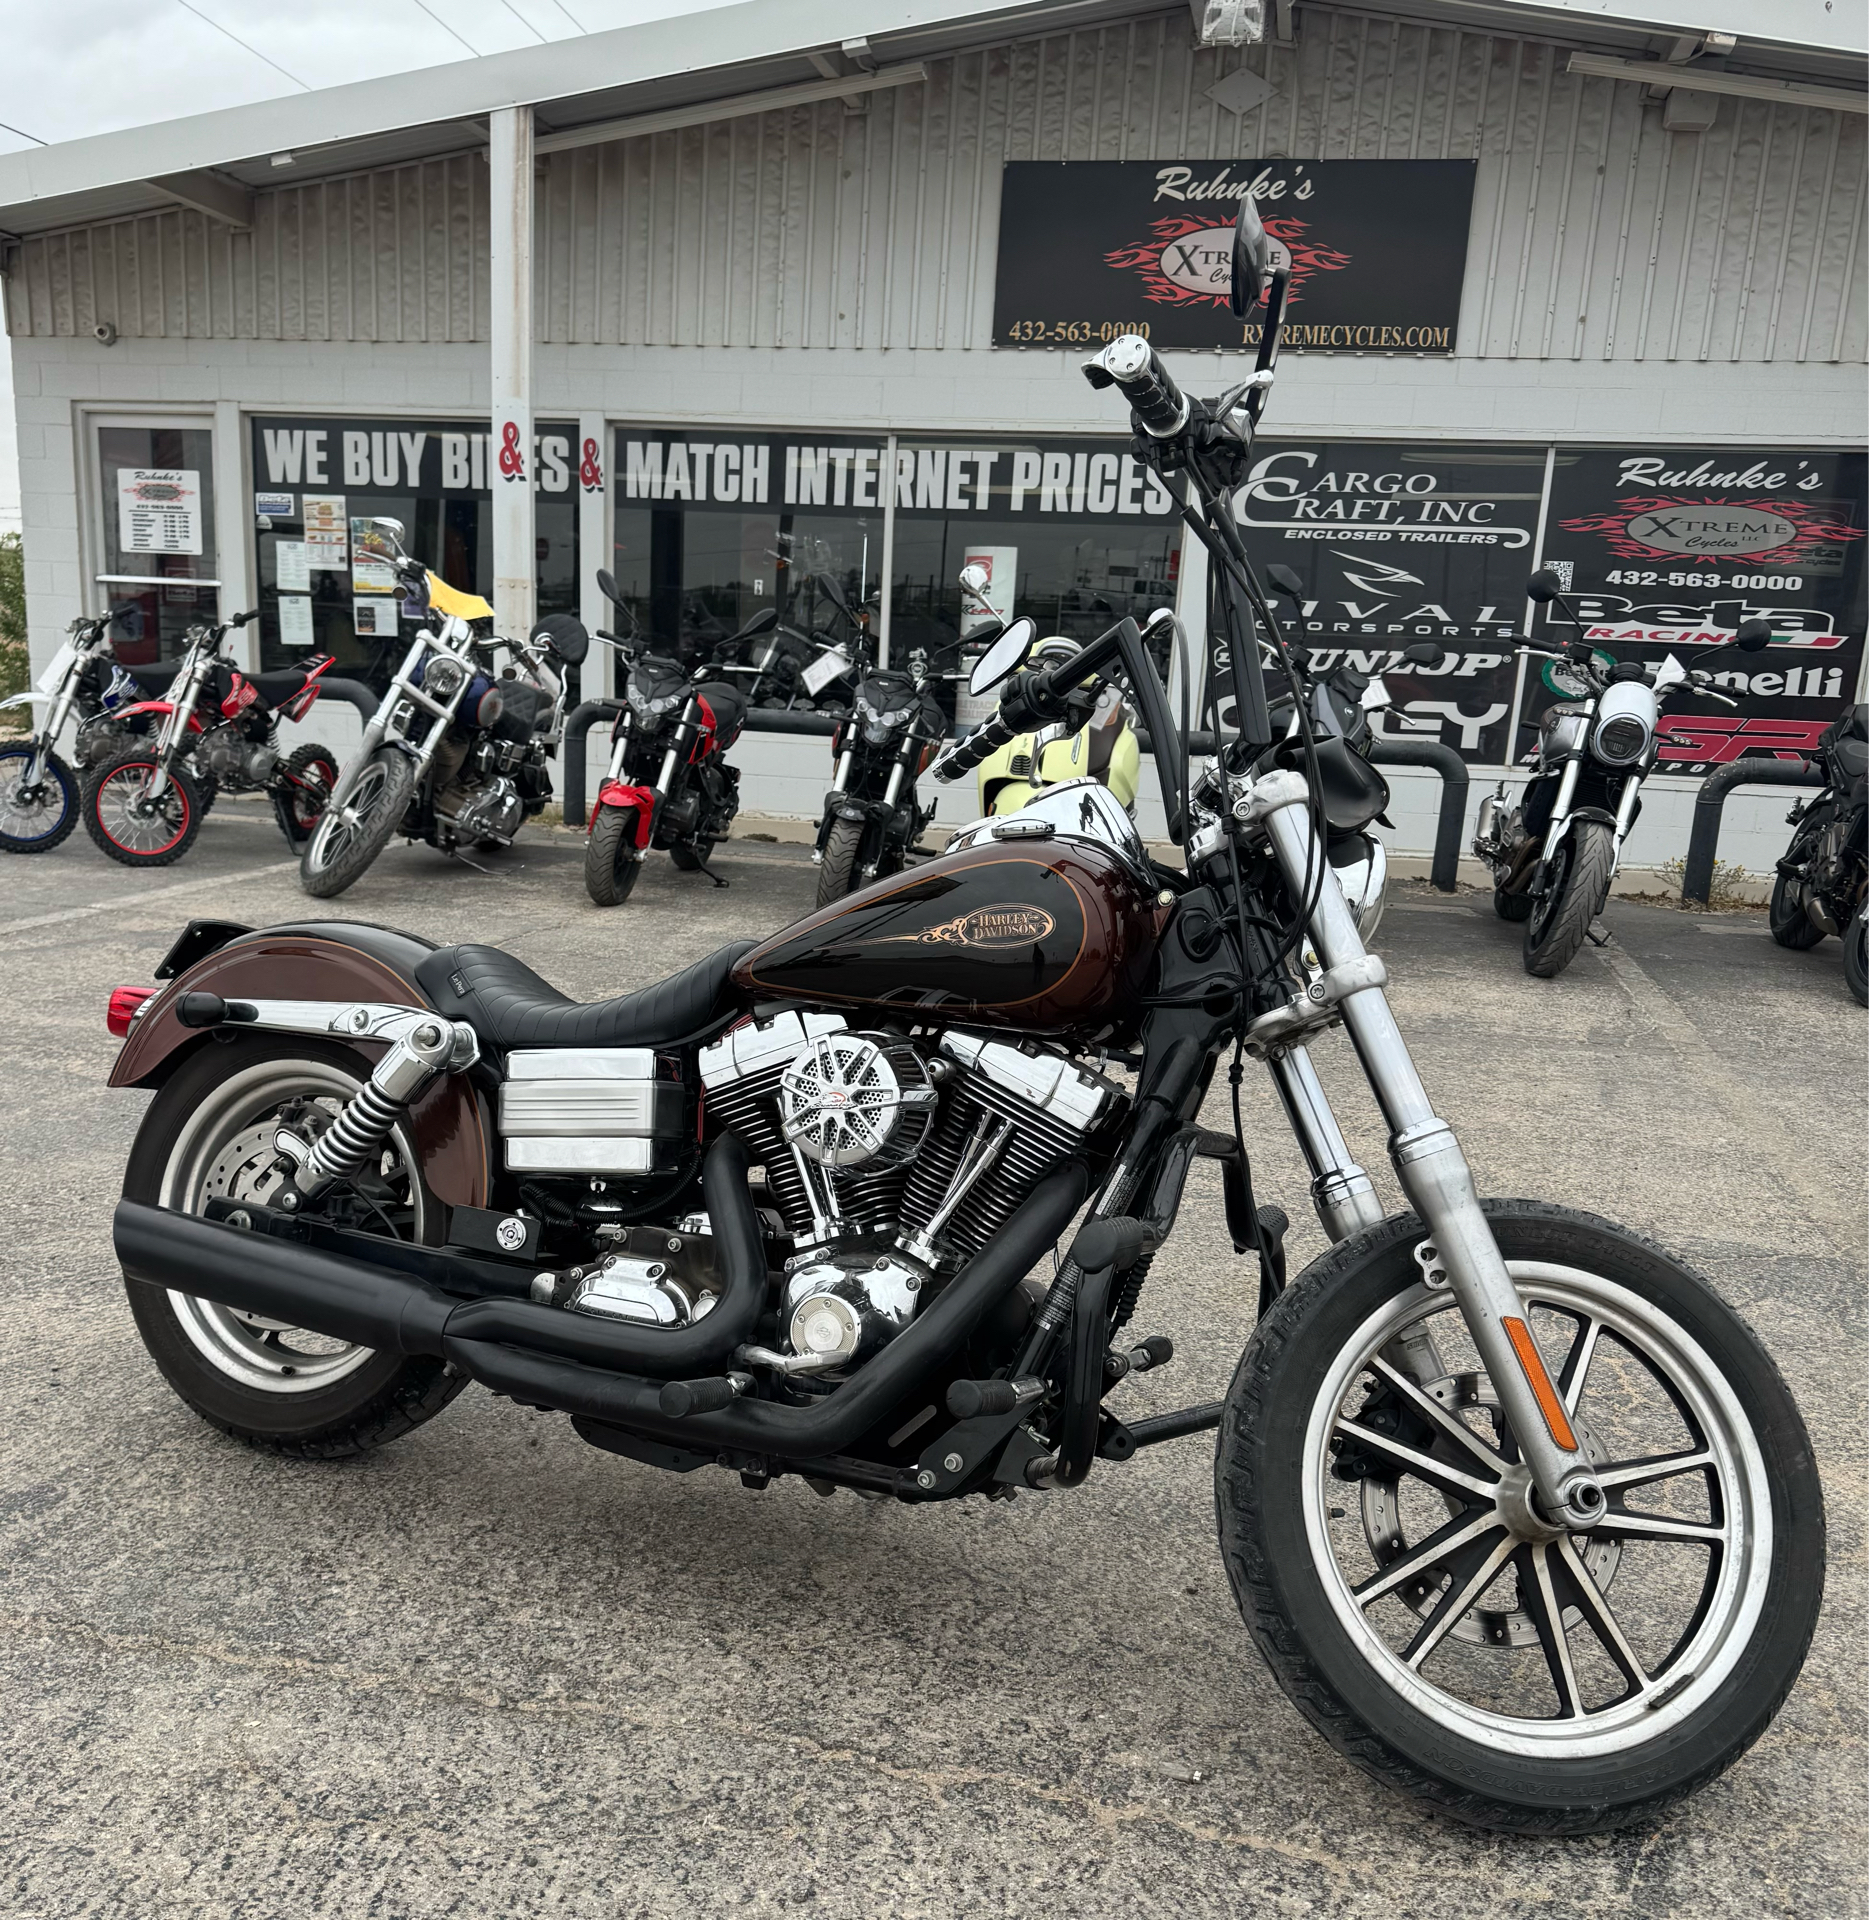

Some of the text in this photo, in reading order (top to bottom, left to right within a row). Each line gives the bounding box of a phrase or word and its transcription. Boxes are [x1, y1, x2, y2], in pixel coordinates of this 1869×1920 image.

[1153, 166, 1314, 202] Ruhnke's
[1170, 244, 1281, 277] XTRE
[1008, 320, 1150, 342] 432-563-0000
[1242, 323, 1450, 348] RXREMECYCLES.COM
[262, 429, 328, 484] WE
[343, 431, 427, 488] BUY
[626, 440, 1175, 515] MATCH INTERNET PRICES
[1248, 451, 1437, 502] CARGO
[1615, 457, 1823, 491] Ruhnke's
[1415, 501, 1496, 524] INC
[1284, 529, 1499, 545] ENCLOSED TRAILERS
[1639, 516, 1788, 538] XTREME
[1684, 535, 1739, 550] Cycles
[1605, 570, 1803, 591] 432-563-0000
[1255, 620, 1513, 638] OTORSPORTS
[1586, 627, 1738, 644] RACIN
[978, 912, 1030, 927] HARLEY
[973, 923, 1038, 940] DAVIDSON
